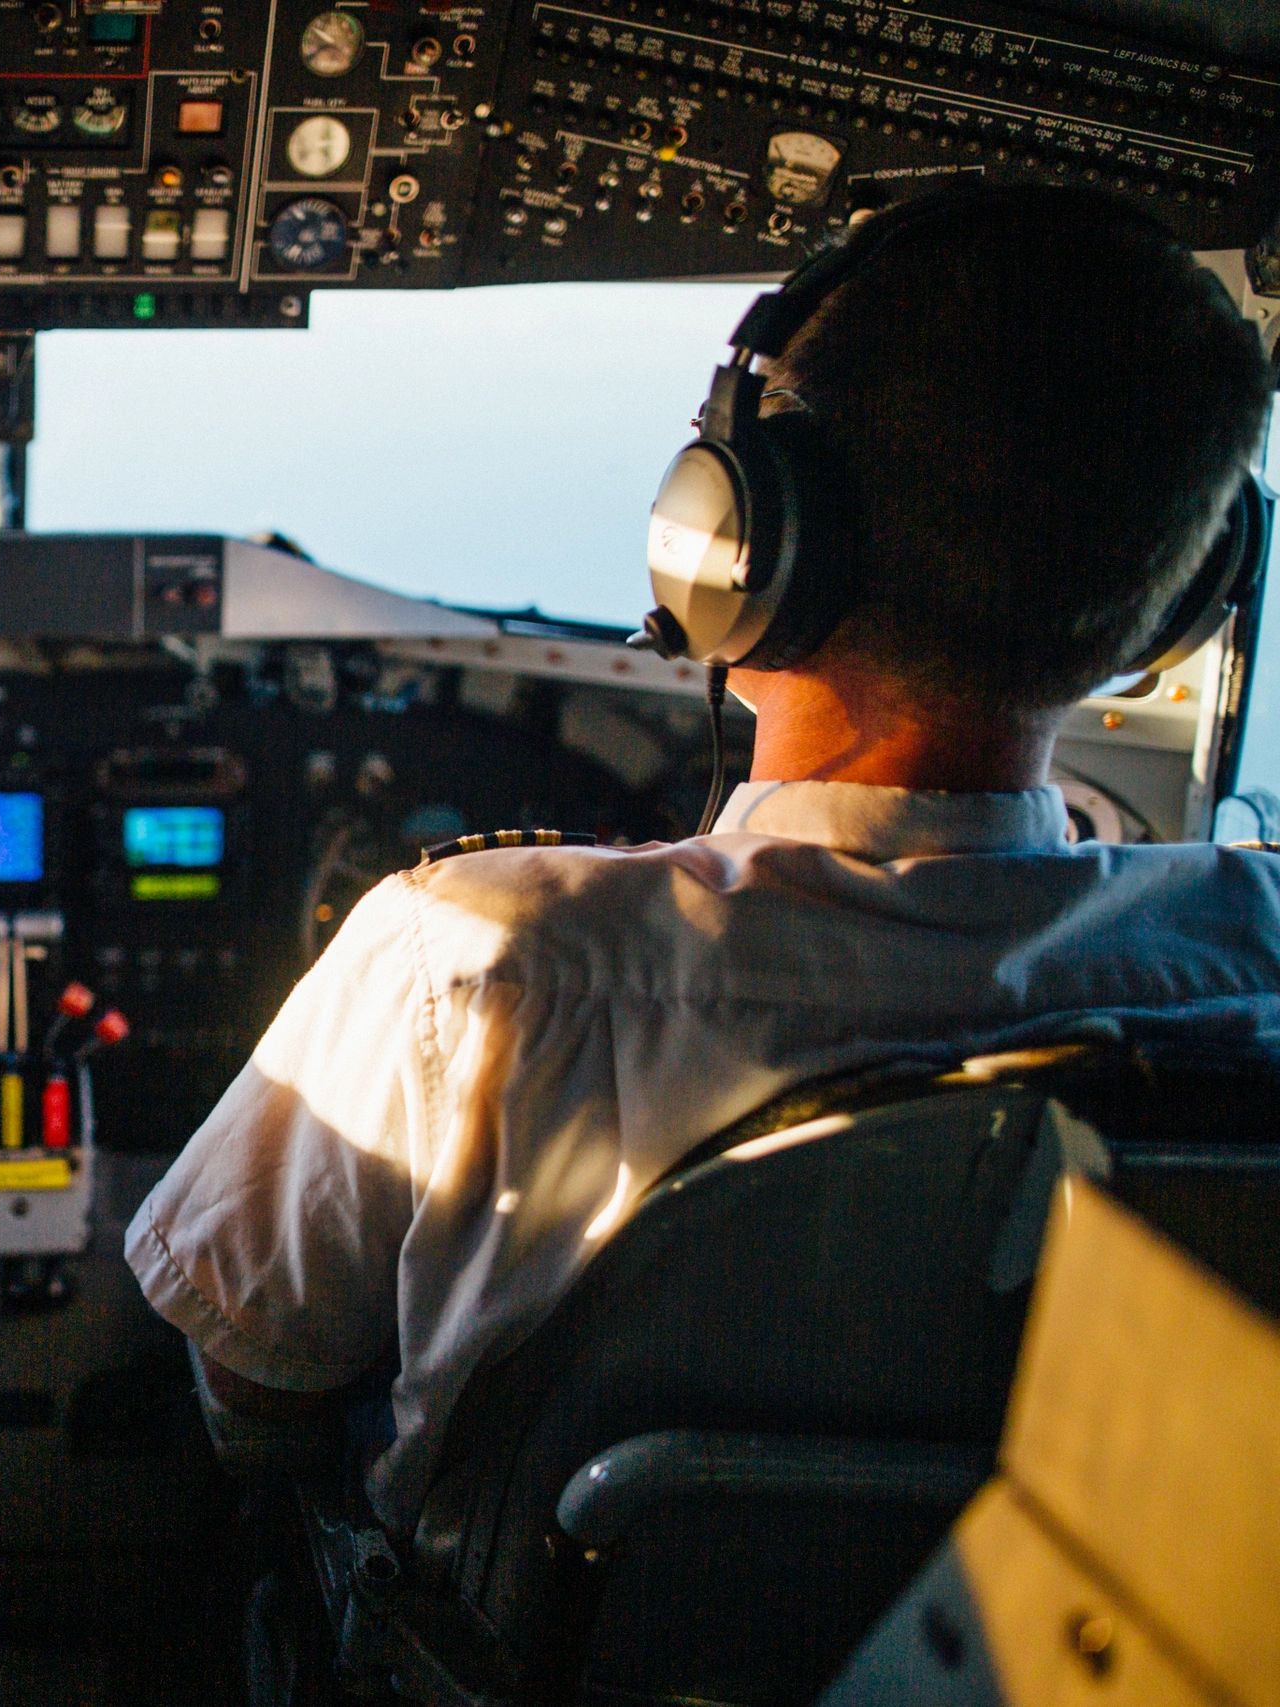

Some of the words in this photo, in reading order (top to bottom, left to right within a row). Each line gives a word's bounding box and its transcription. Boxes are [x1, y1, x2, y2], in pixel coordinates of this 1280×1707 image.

[1005, 41, 1026, 53] TURN
[1033, 56, 1051, 66] NAV
[1114, 48, 1137, 61] LEFT
[1136, 54, 1179, 70] AVIONICS
[1180, 63, 1201, 73] BUS
[1063, 62, 1082, 72] COM
[1089, 67, 1118, 79] PILOTS
[1218, 93, 1243, 104] GYRO
[1034, 128, 1053, 138] COM
[1035, 115, 1062, 130] RIGHT
[1062, 120, 1103, 138] AVIONICS
[1103, 130, 1123, 142] BUS
[1157, 155, 1174, 164] RAD
[915, 164, 958, 177] LIGHTING
